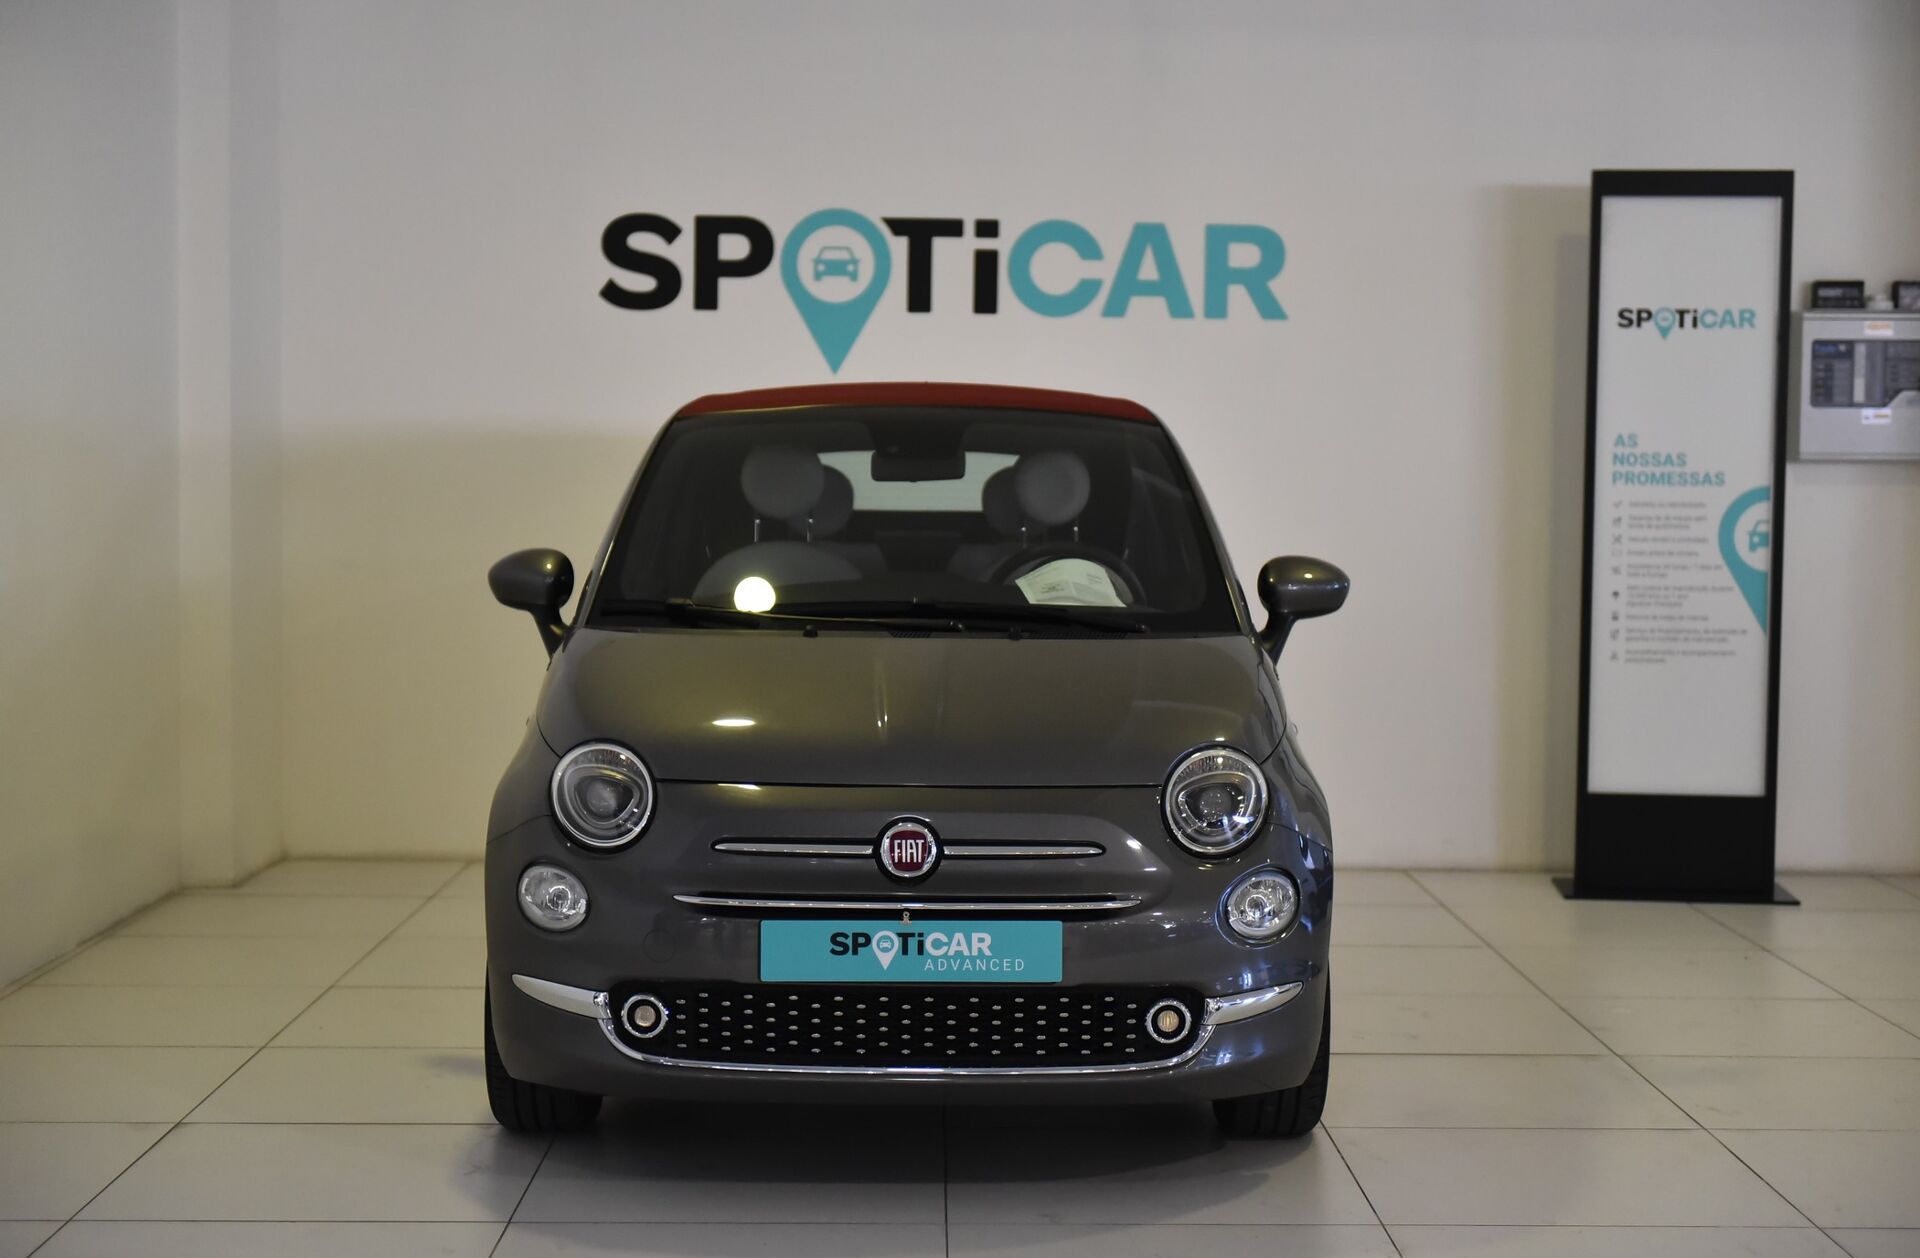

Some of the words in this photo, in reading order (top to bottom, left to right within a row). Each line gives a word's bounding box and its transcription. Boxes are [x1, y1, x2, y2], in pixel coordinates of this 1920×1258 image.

[1613, 432, 1639, 449] AS
[1612, 452, 1688, 468] NOSSAS
[1612, 470, 1726, 487] PROMESSAS
[893, 839, 925, 863] FIAT
[923, 958, 1025, 972] ADVANCED
